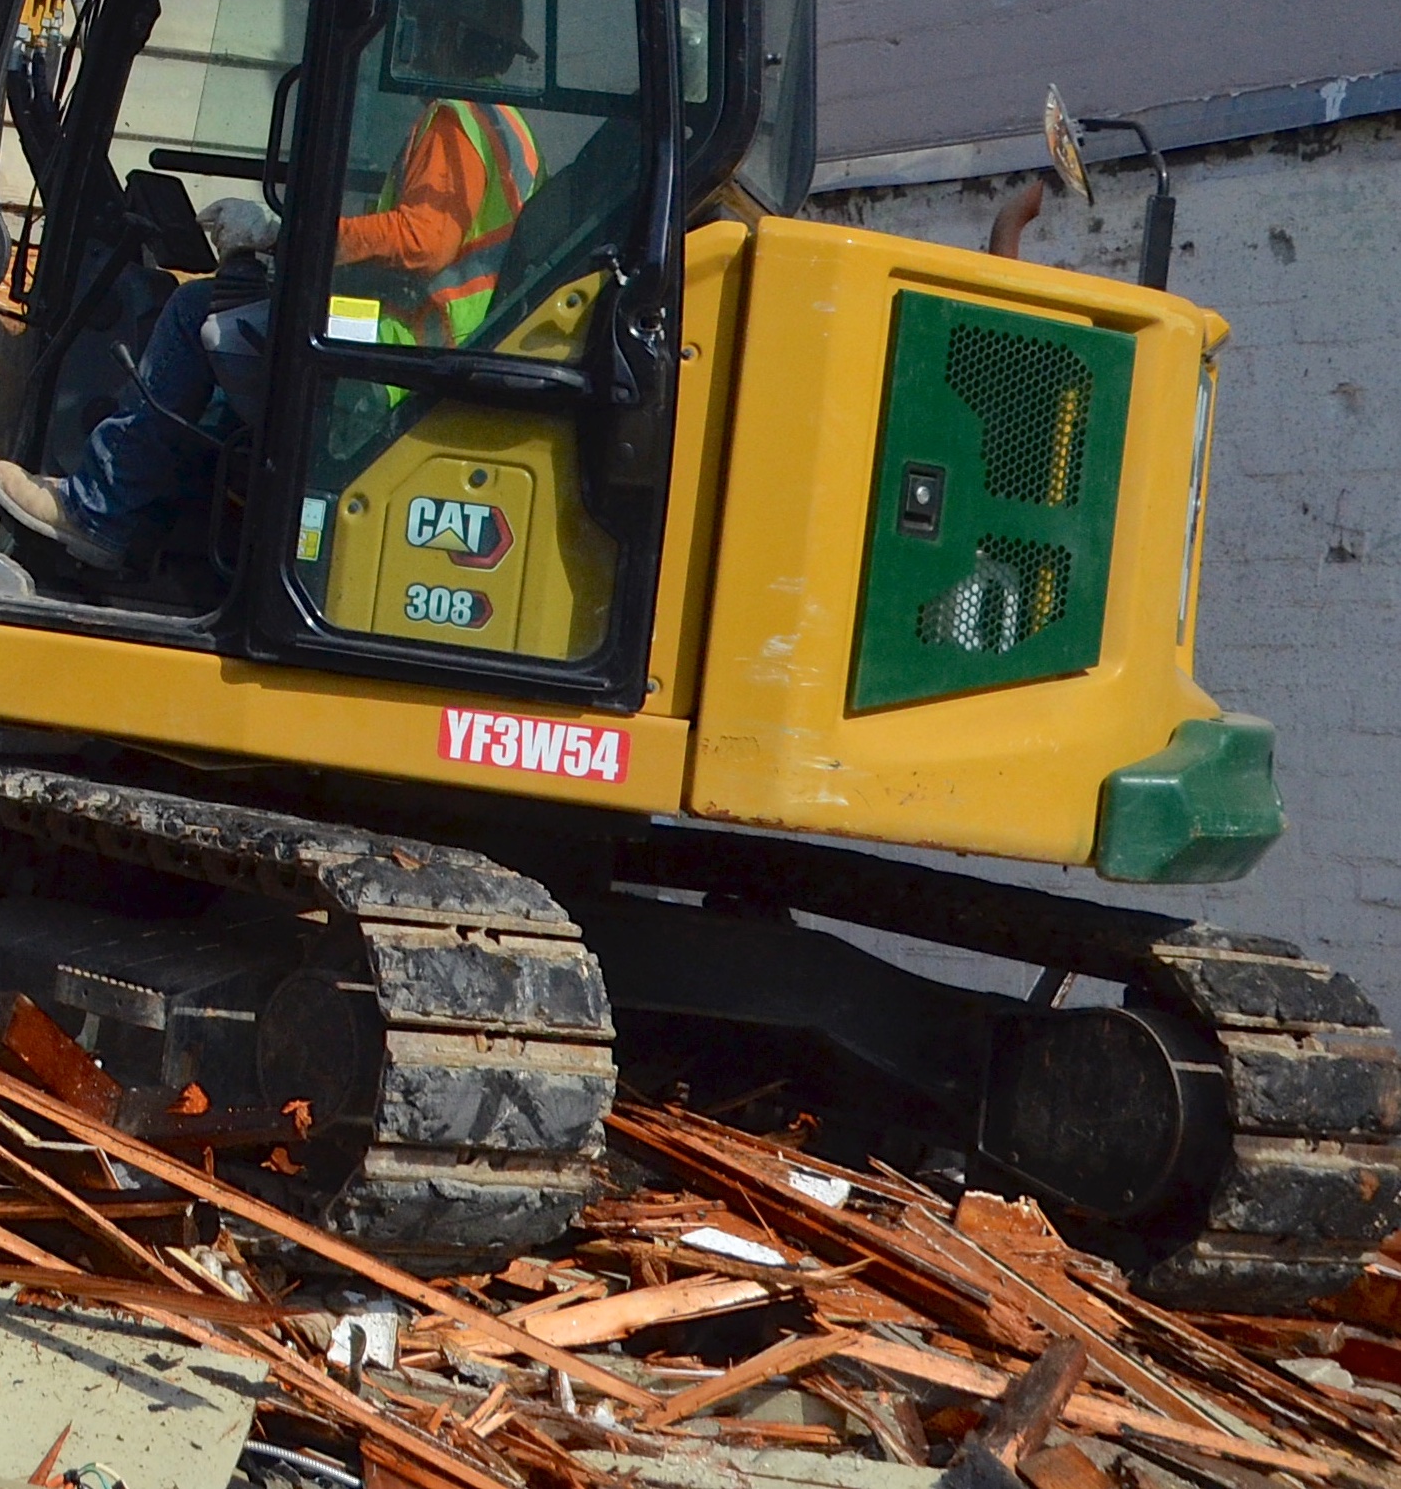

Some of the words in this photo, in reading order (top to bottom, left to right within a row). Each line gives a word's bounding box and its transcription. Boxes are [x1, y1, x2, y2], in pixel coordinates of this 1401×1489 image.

[407, 496, 490, 553] CAT
[406, 583, 473, 625] 308
[446, 709, 620, 781] YF3W54
